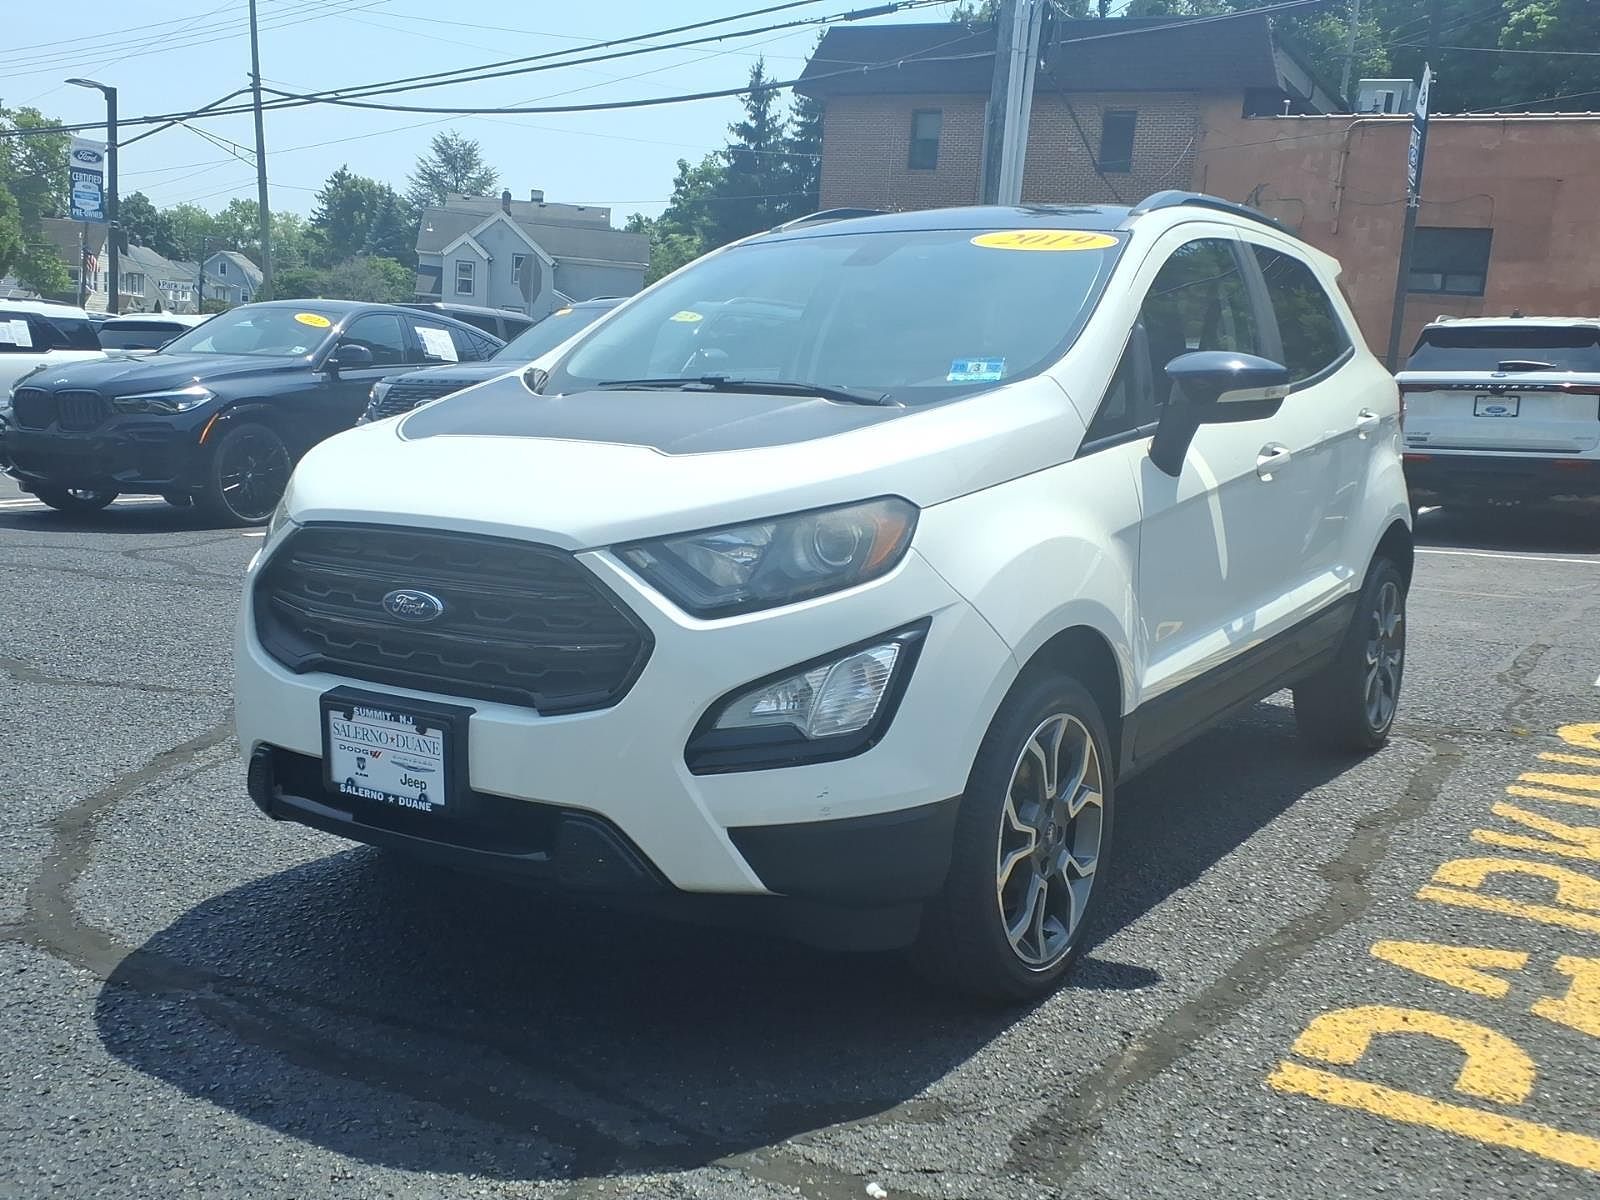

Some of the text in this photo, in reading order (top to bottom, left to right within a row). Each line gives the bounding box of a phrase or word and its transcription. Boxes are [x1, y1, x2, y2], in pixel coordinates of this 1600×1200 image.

[77, 150, 98, 161] Ford
[72, 171, 102, 185] CERTIFIED
[72, 208, 104, 219] PRE-OWNED
[992, 233, 1097, 246] 2019
[163, 280, 177, 290] Park
[392, 594, 425, 614] Ford
[400, 714, 413, 725] NJ
[333, 722, 440, 756] SALERNO DUANE
[400, 773, 427, 792] Jeep
[340, 783, 432, 812] SALERNO DUANE
